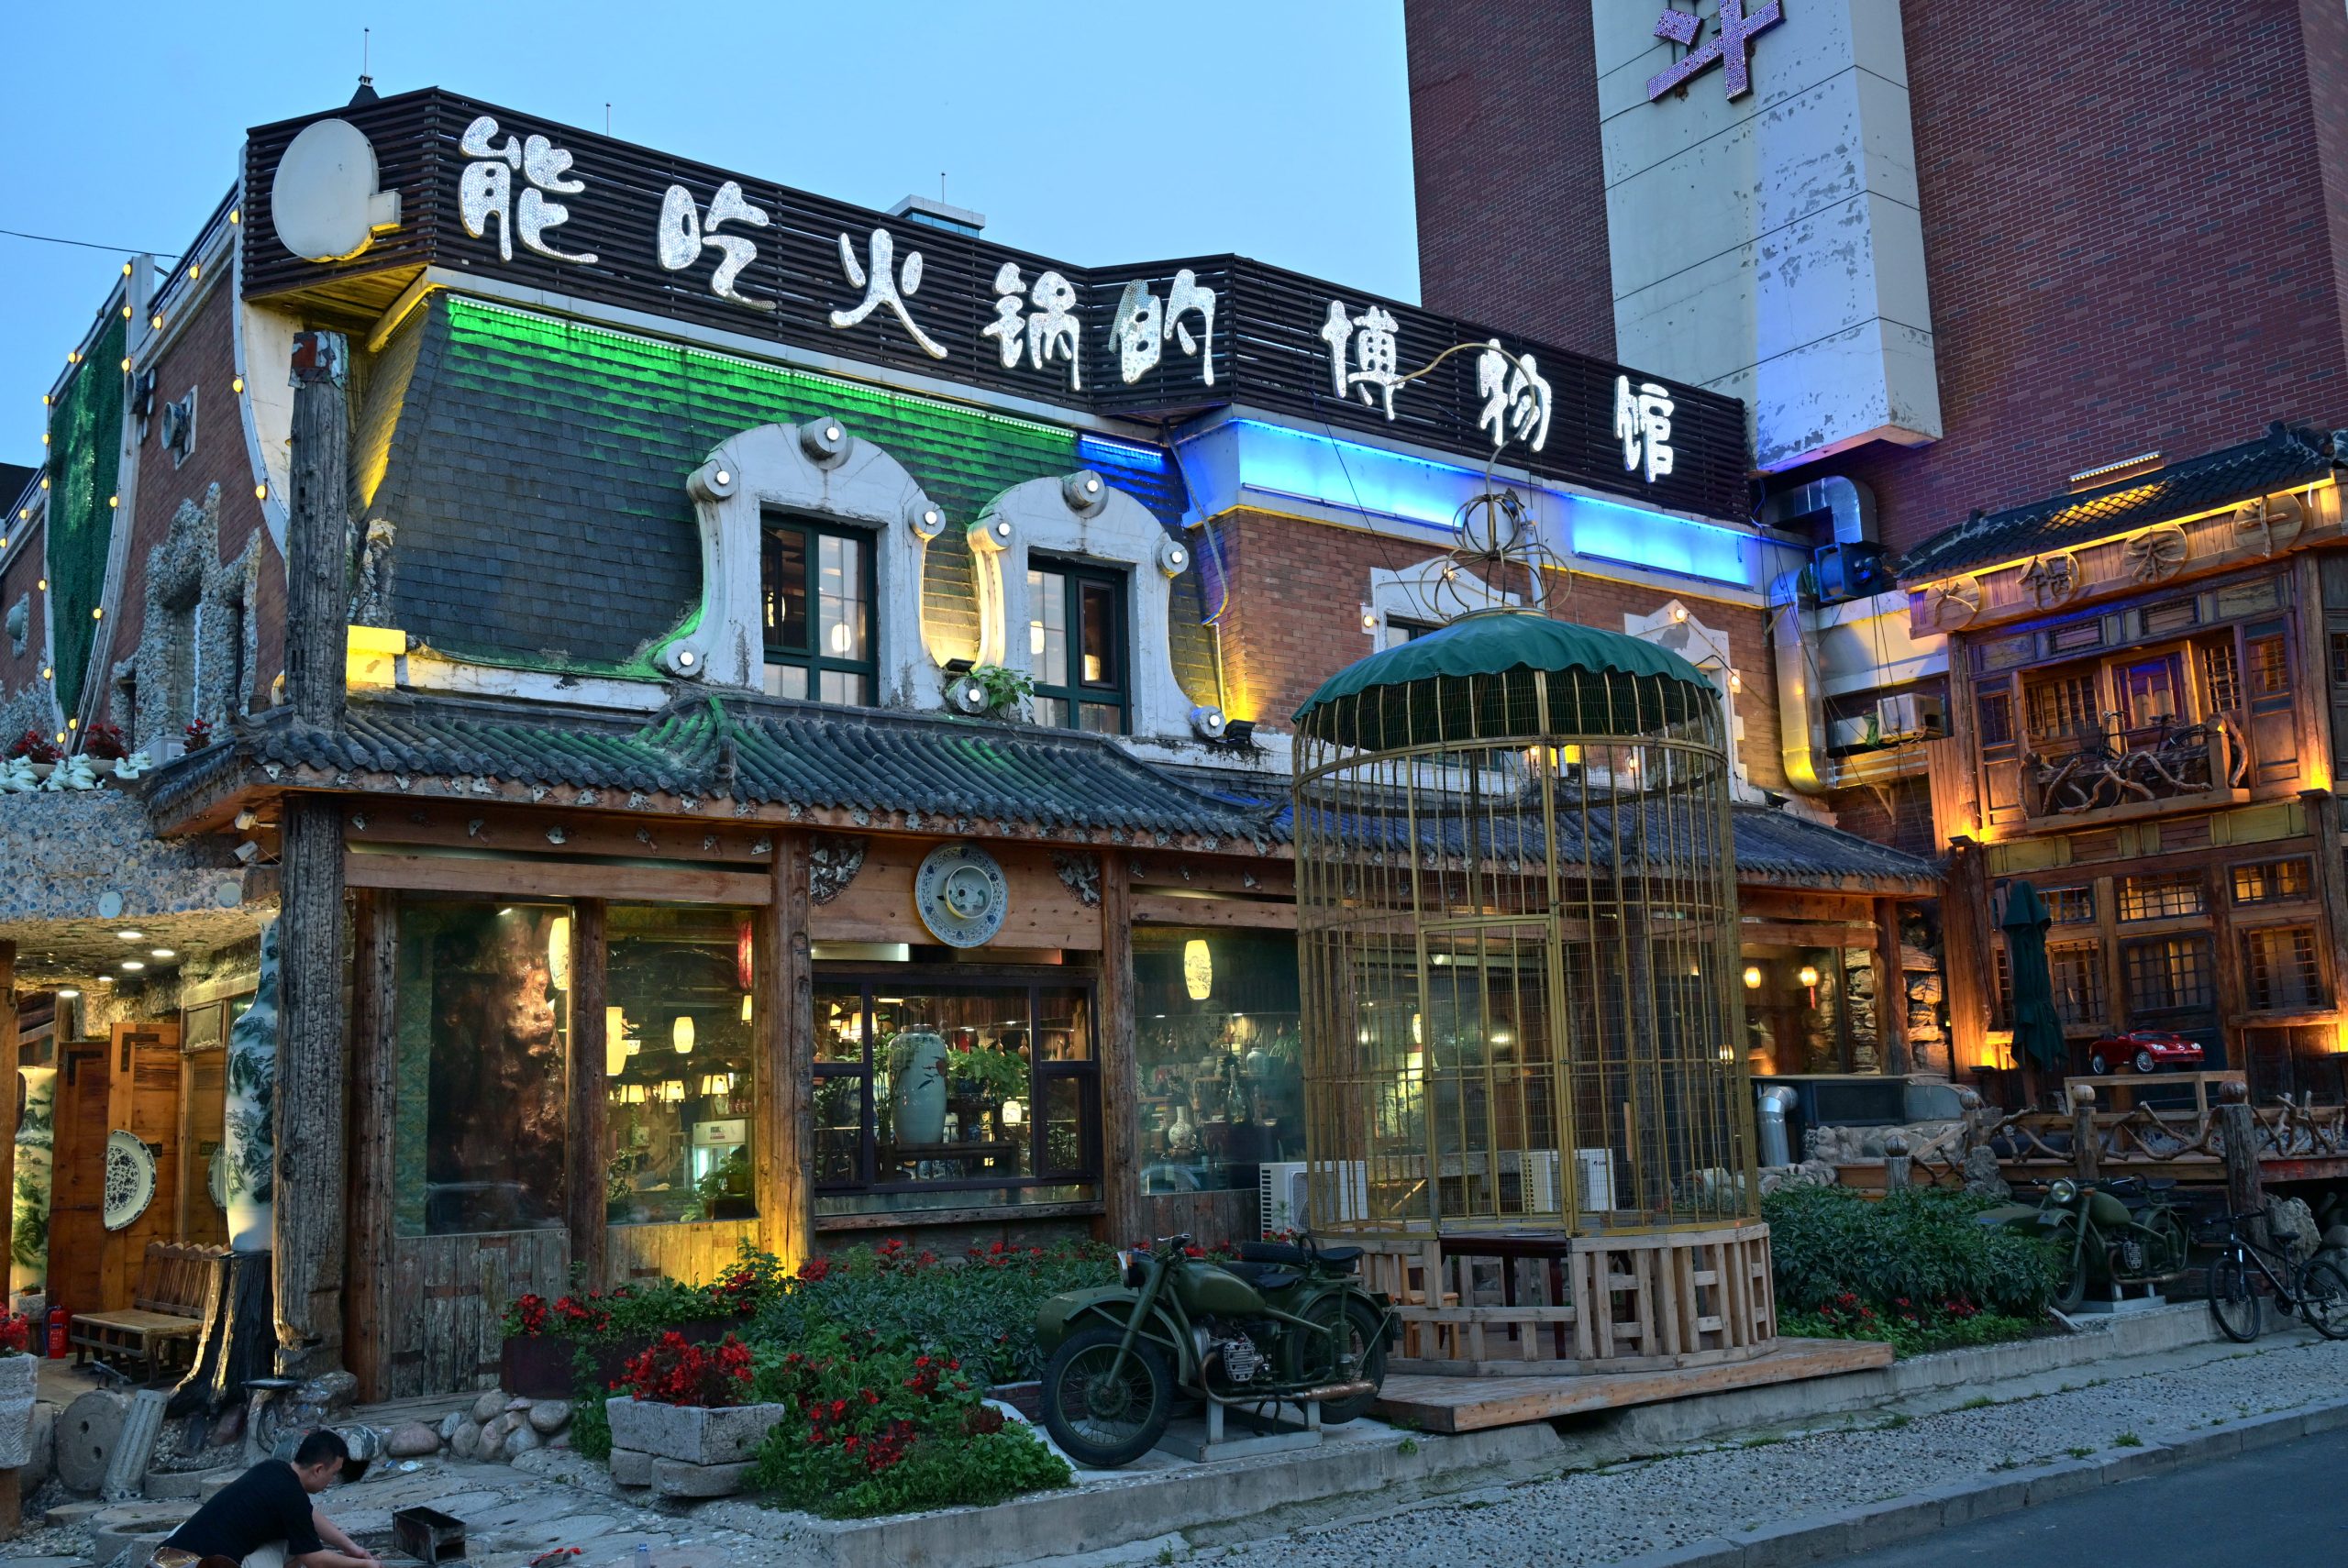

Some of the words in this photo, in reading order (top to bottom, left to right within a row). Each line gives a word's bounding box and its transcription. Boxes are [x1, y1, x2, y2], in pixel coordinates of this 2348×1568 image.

[460, 116, 1675, 483] 能吃火锅的博物馆
